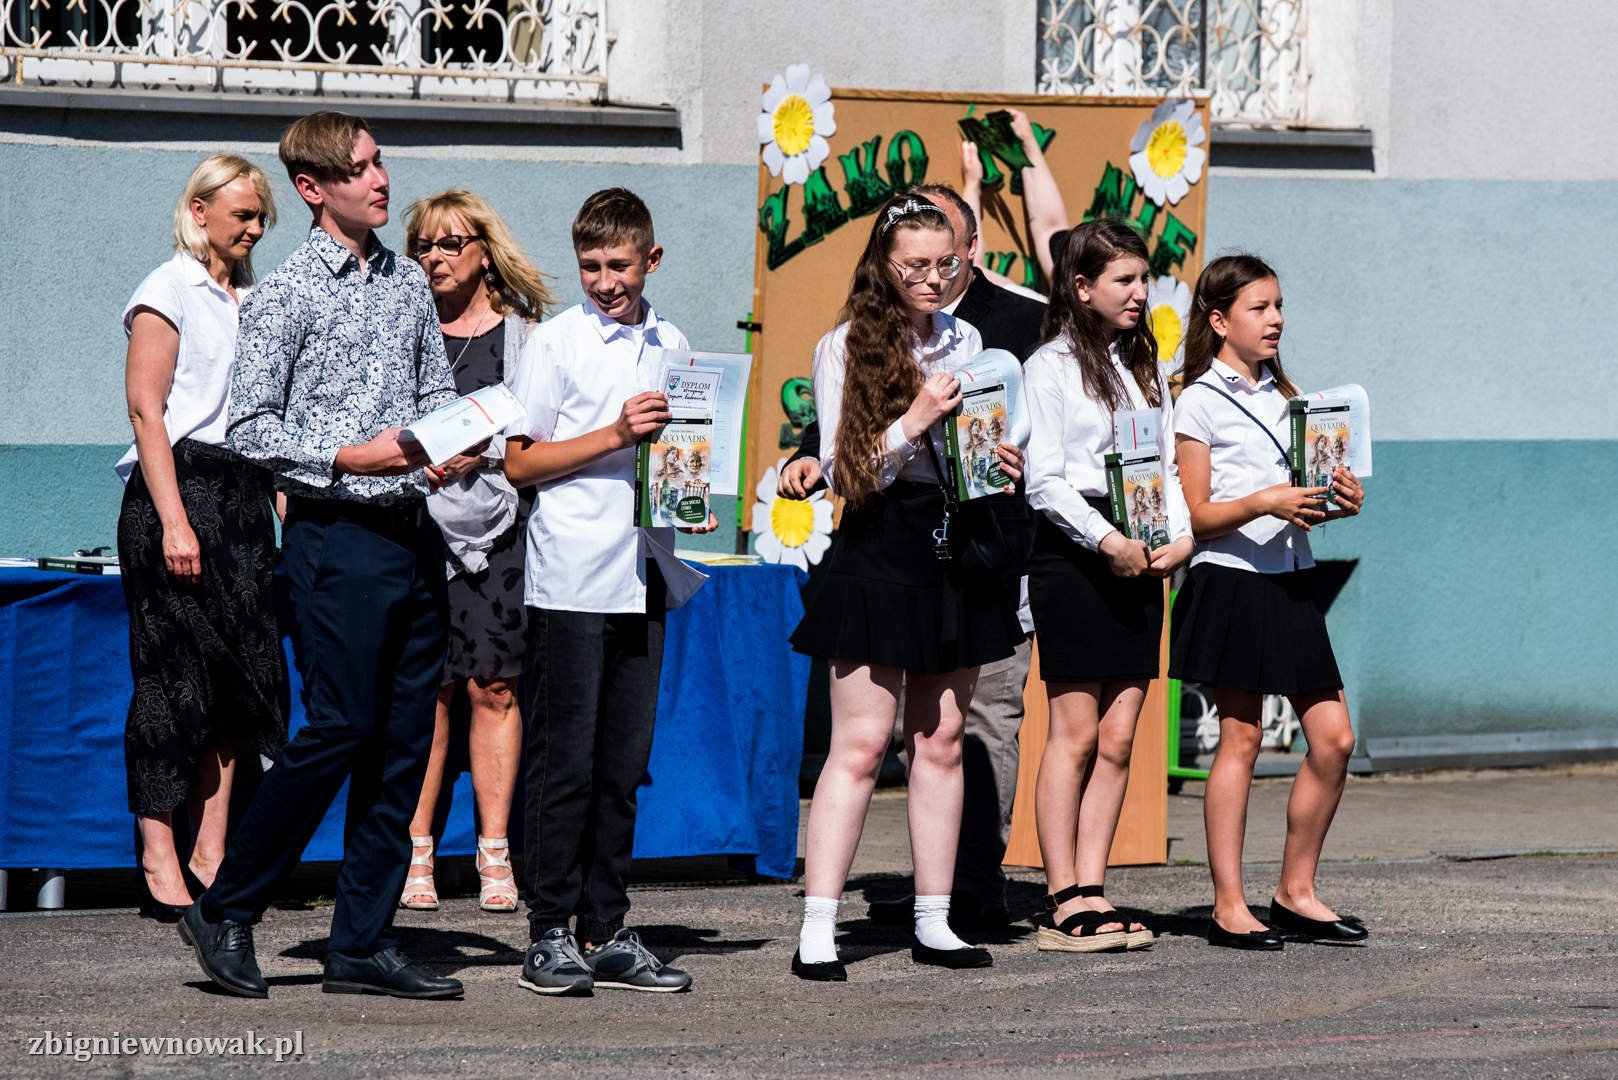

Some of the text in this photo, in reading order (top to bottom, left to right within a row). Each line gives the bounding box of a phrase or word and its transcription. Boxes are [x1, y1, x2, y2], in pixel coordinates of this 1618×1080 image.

[681, 382, 711, 391] DYPLOM
[982, 402, 1001, 412] VADIS
[659, 433, 706, 445] QUO VADIS
